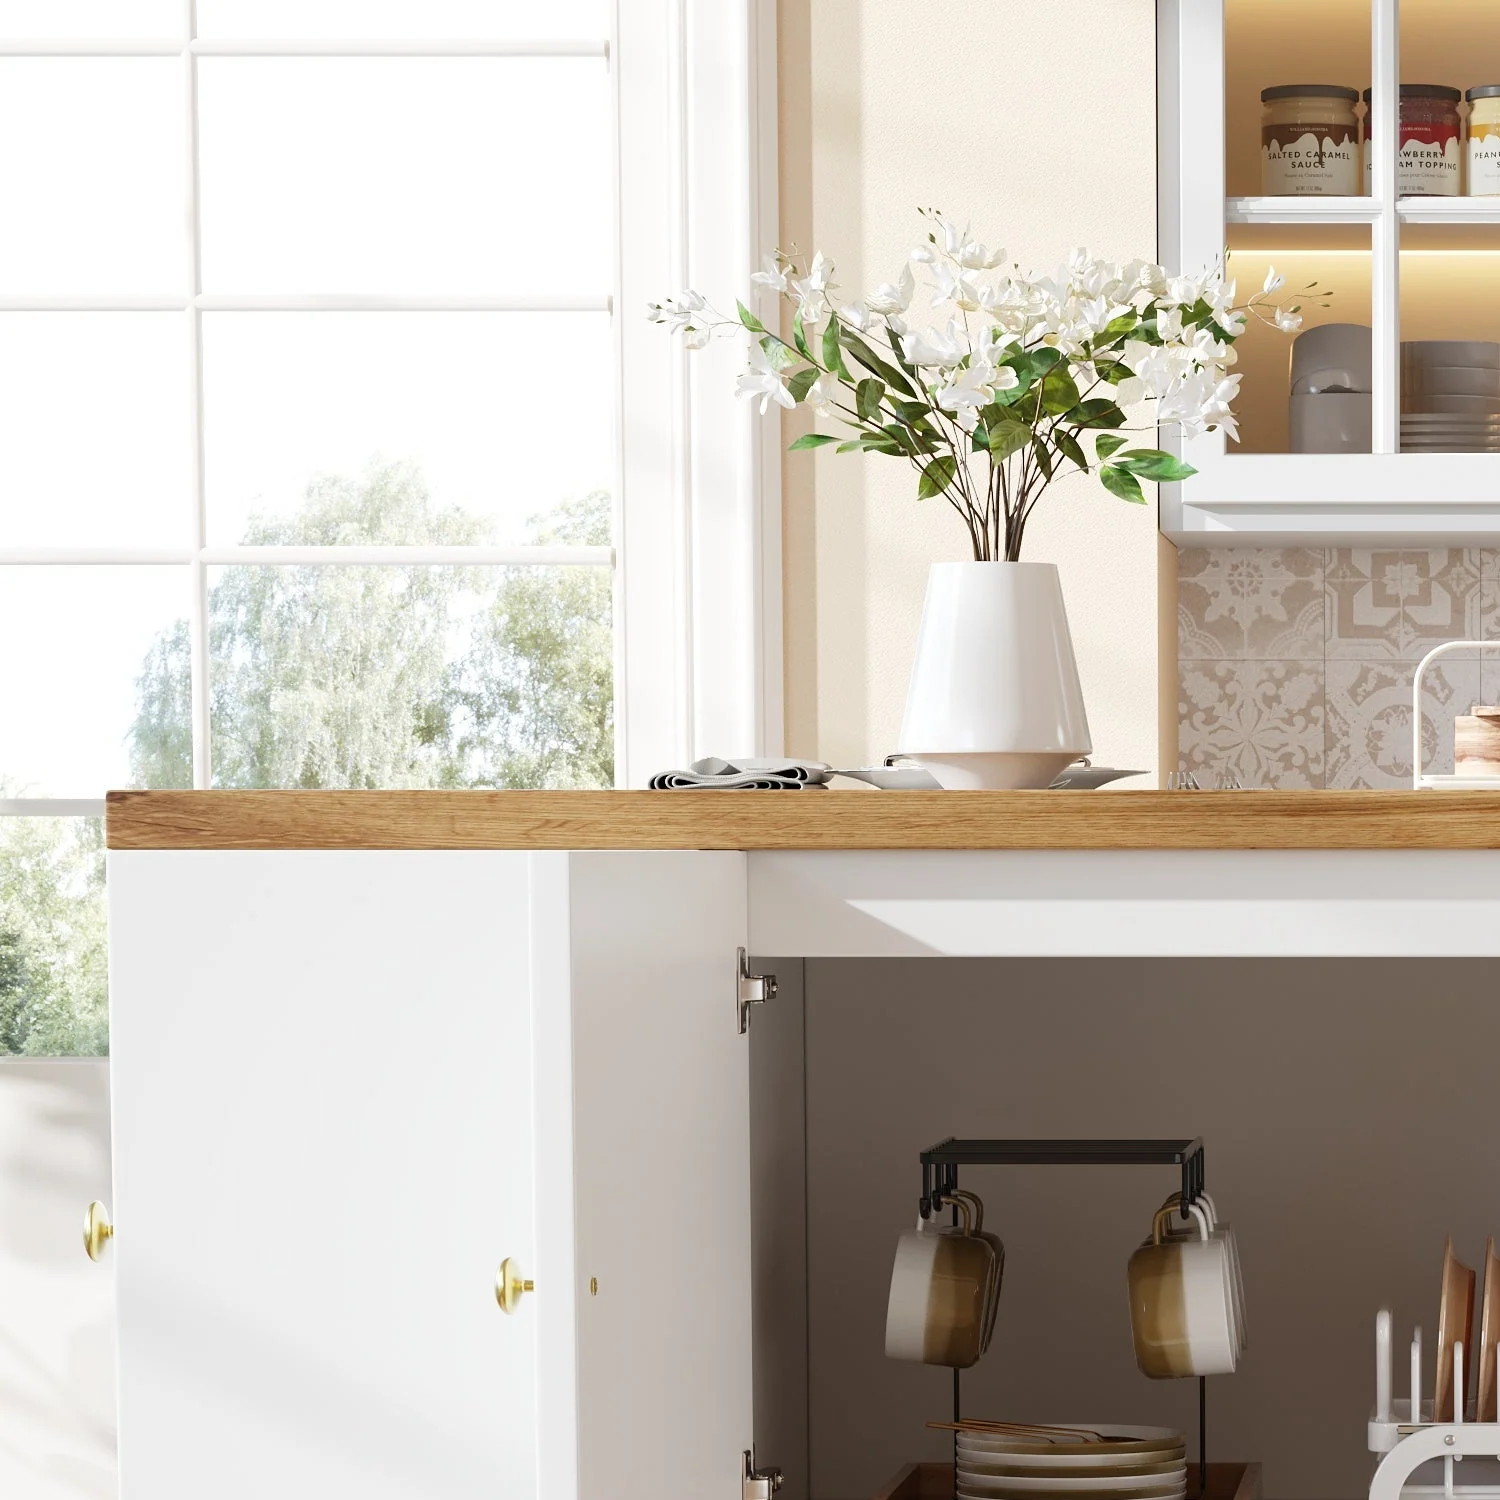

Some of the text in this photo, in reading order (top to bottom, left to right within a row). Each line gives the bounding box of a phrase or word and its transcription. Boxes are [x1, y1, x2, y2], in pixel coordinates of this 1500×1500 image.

[1268, 151, 1350, 160] SALTED CARAMEL
[1399, 150, 1444, 159] WBERRY
[1291, 161, 1326, 169] SAUCE
[1419, 161, 1457, 171] TOPPING
